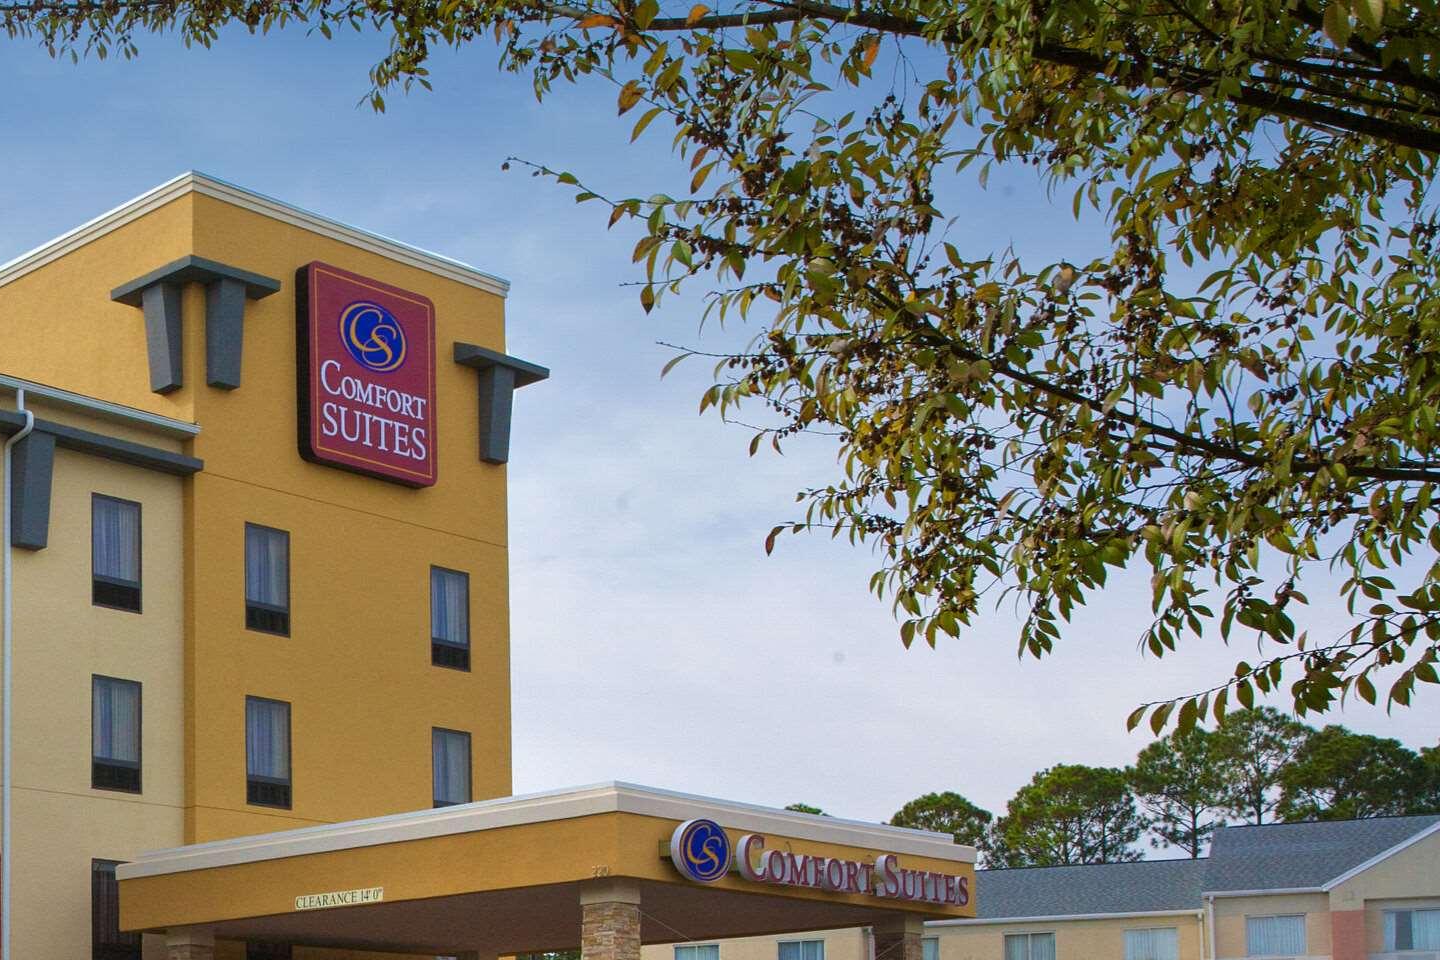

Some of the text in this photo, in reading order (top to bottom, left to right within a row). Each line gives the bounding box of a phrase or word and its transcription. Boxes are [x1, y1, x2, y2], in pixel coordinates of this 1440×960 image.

[320, 360, 427, 420] COMFORT
[322, 402, 427, 461] SUITES
[738, 834, 969, 906] COMFORT SUITES
[296, 892, 358, 908] CLEARANCE
